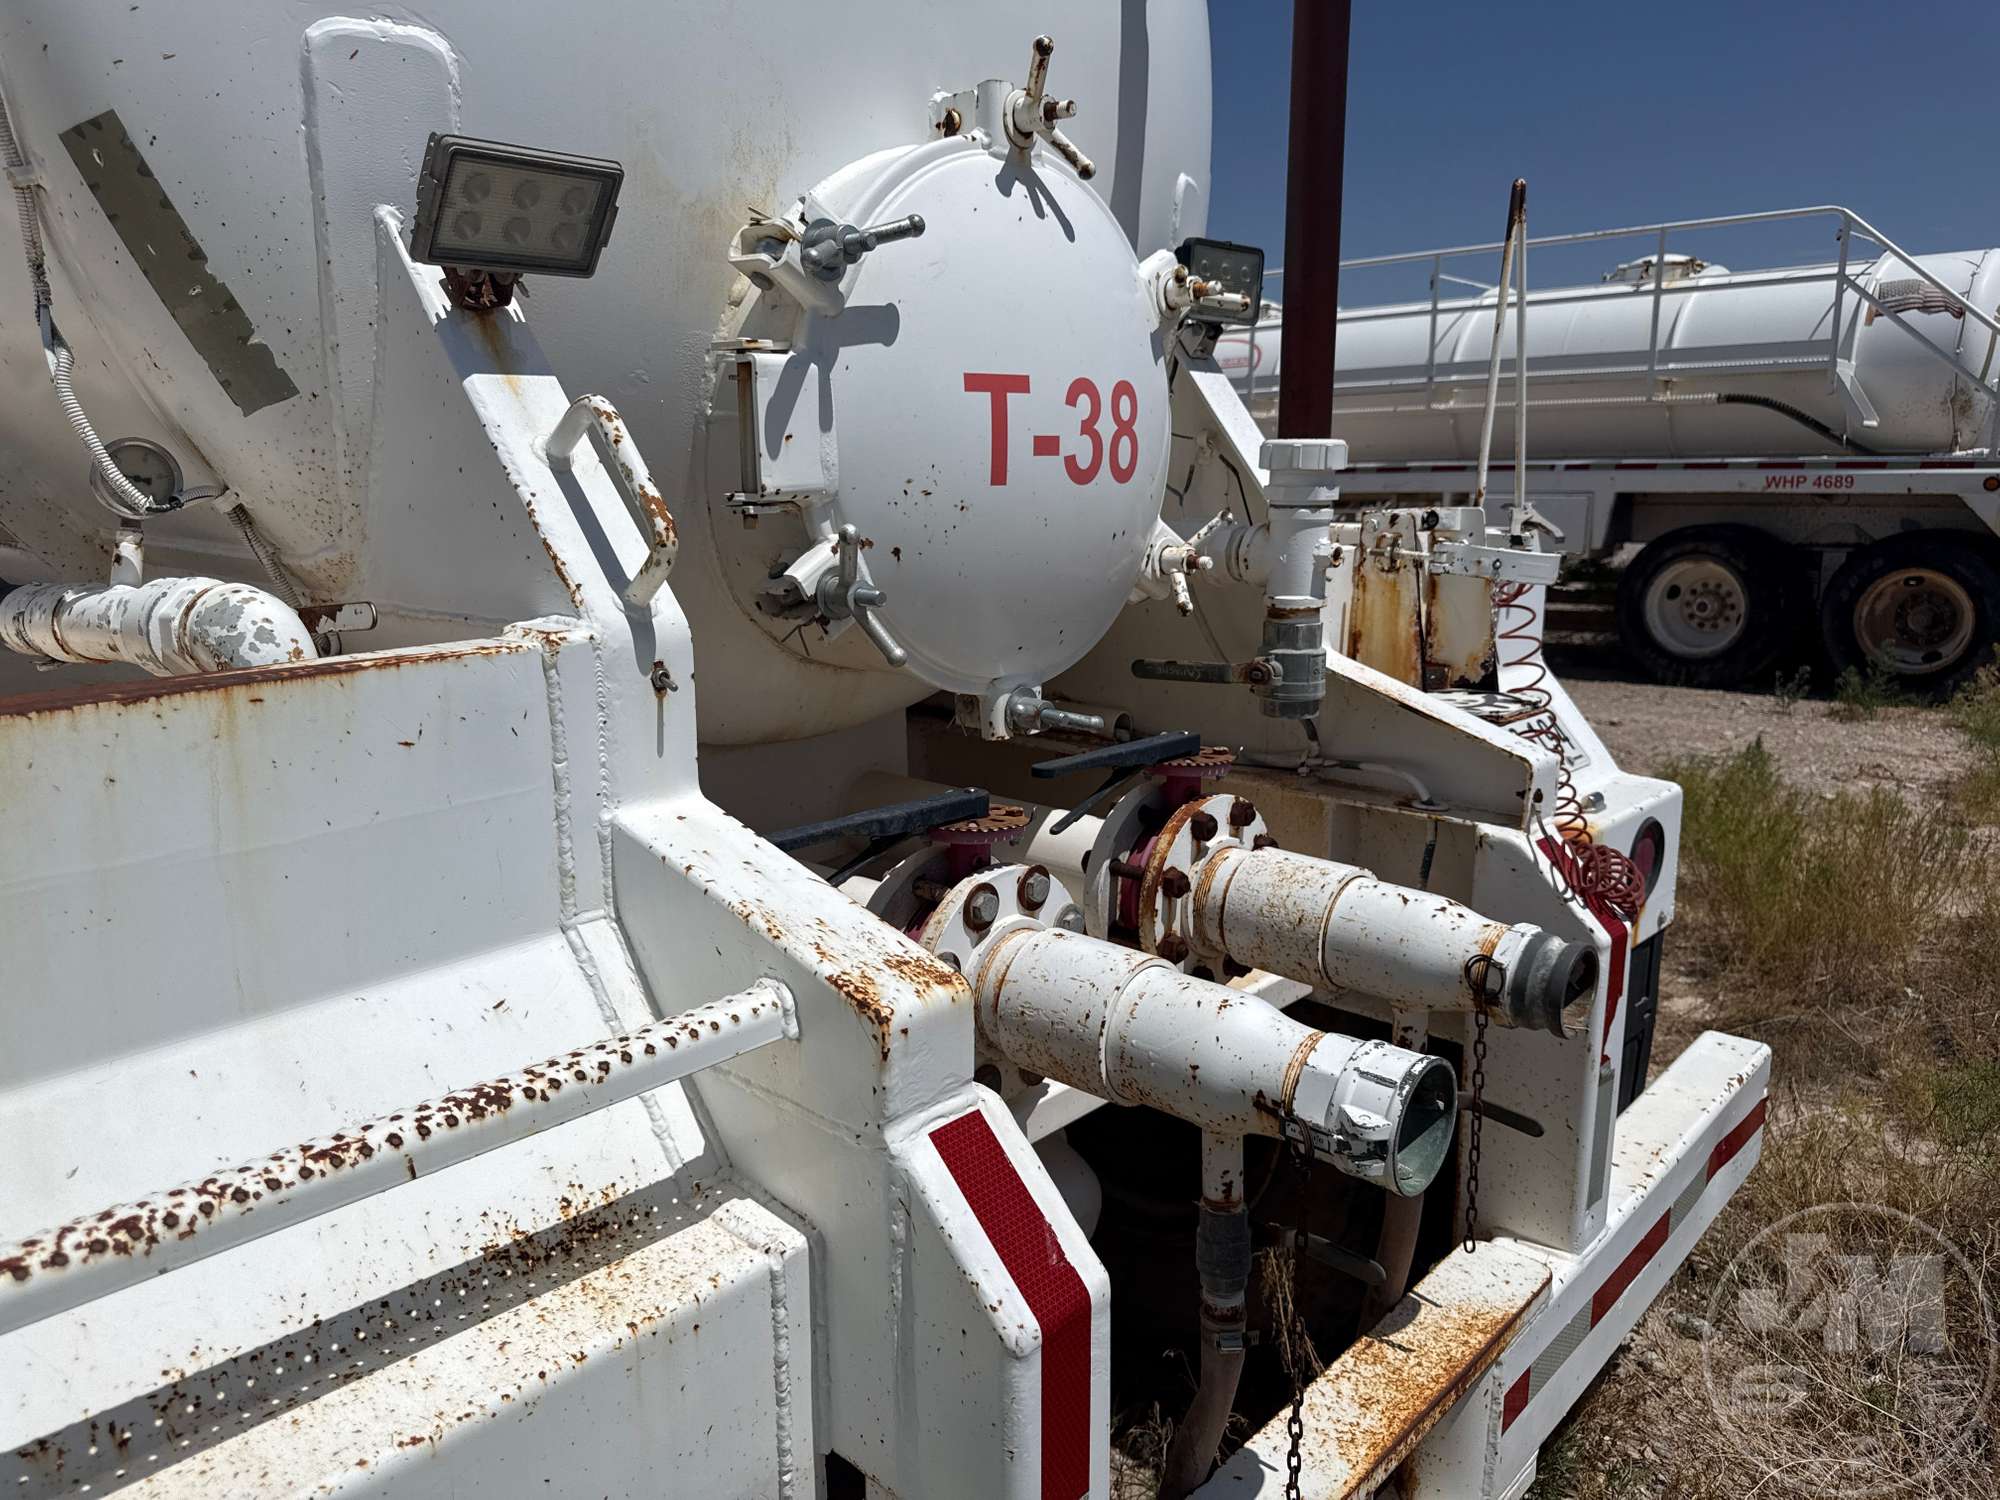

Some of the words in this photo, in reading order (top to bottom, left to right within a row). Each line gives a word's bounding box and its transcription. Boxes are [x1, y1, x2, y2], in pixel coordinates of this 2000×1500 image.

[963, 372, 1138, 486] T-38
[1765, 475, 1807, 489] WHP
[1812, 474, 1855, 489] 4689
